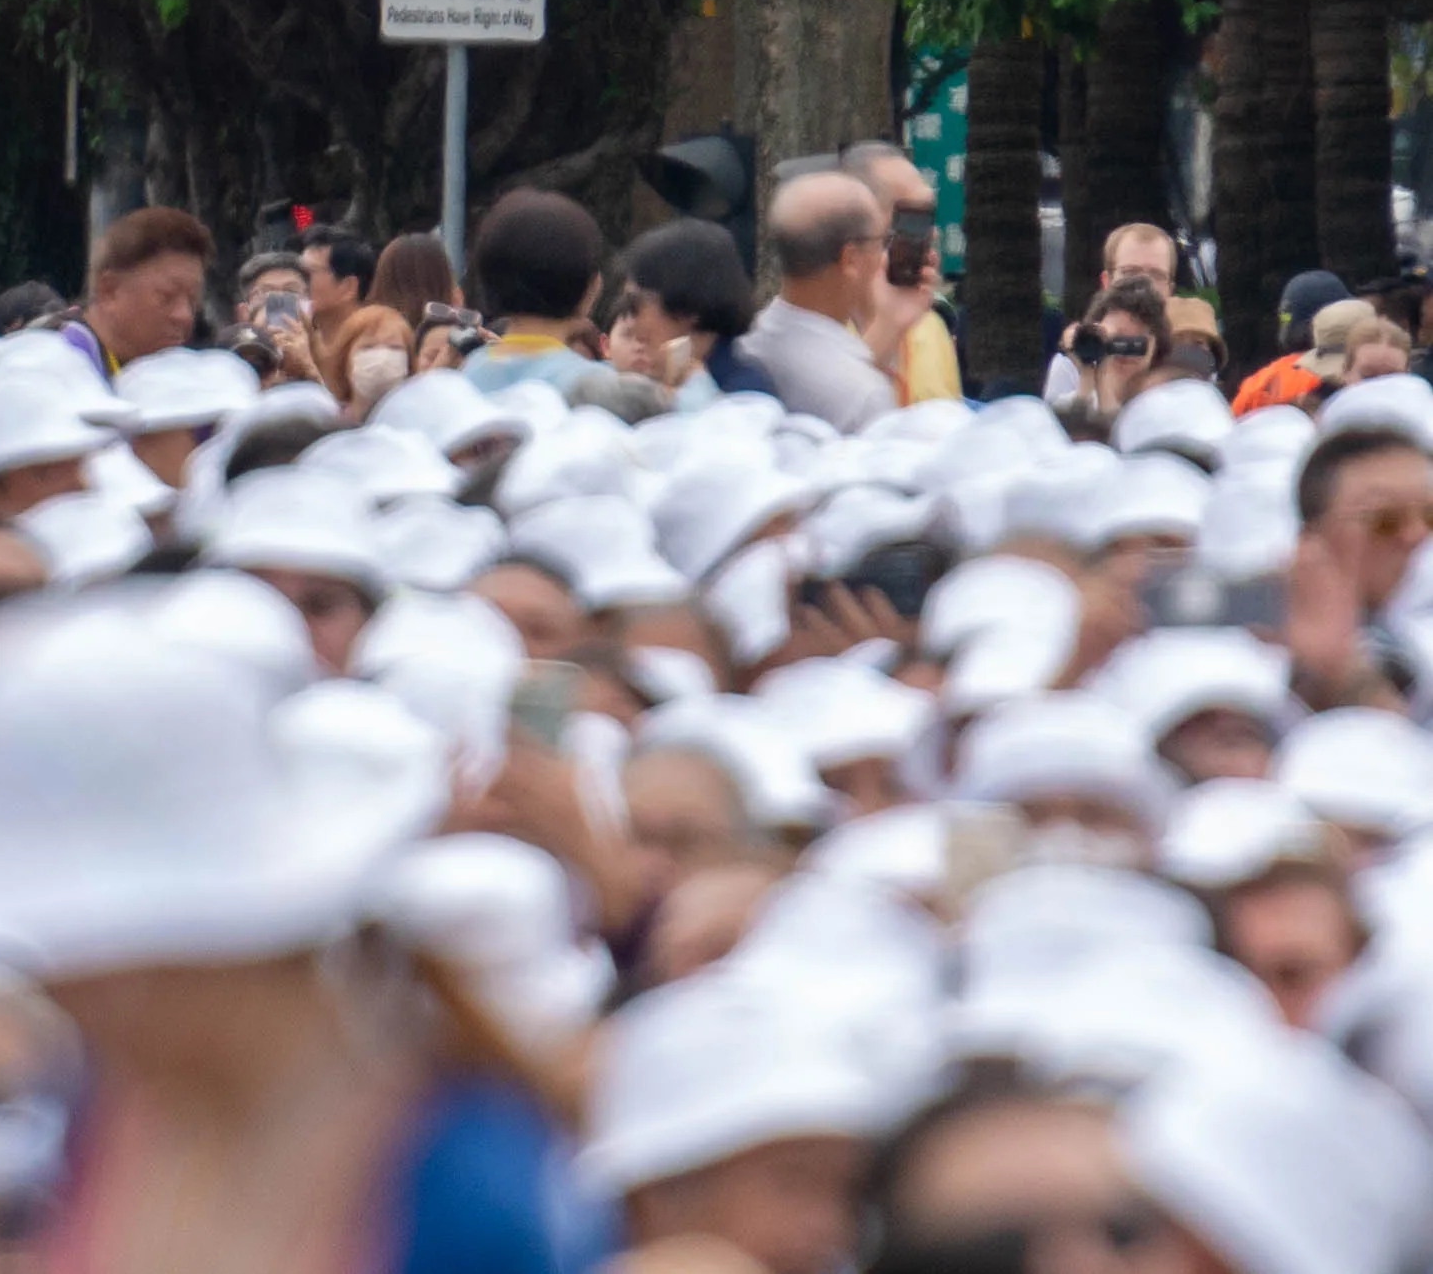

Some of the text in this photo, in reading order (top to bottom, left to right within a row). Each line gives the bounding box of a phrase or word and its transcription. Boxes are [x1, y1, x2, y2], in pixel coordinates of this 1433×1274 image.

[387, 4, 445, 25] Pedestrians
[502, 8, 512, 26] of
[513, 9, 535, 30] Way
